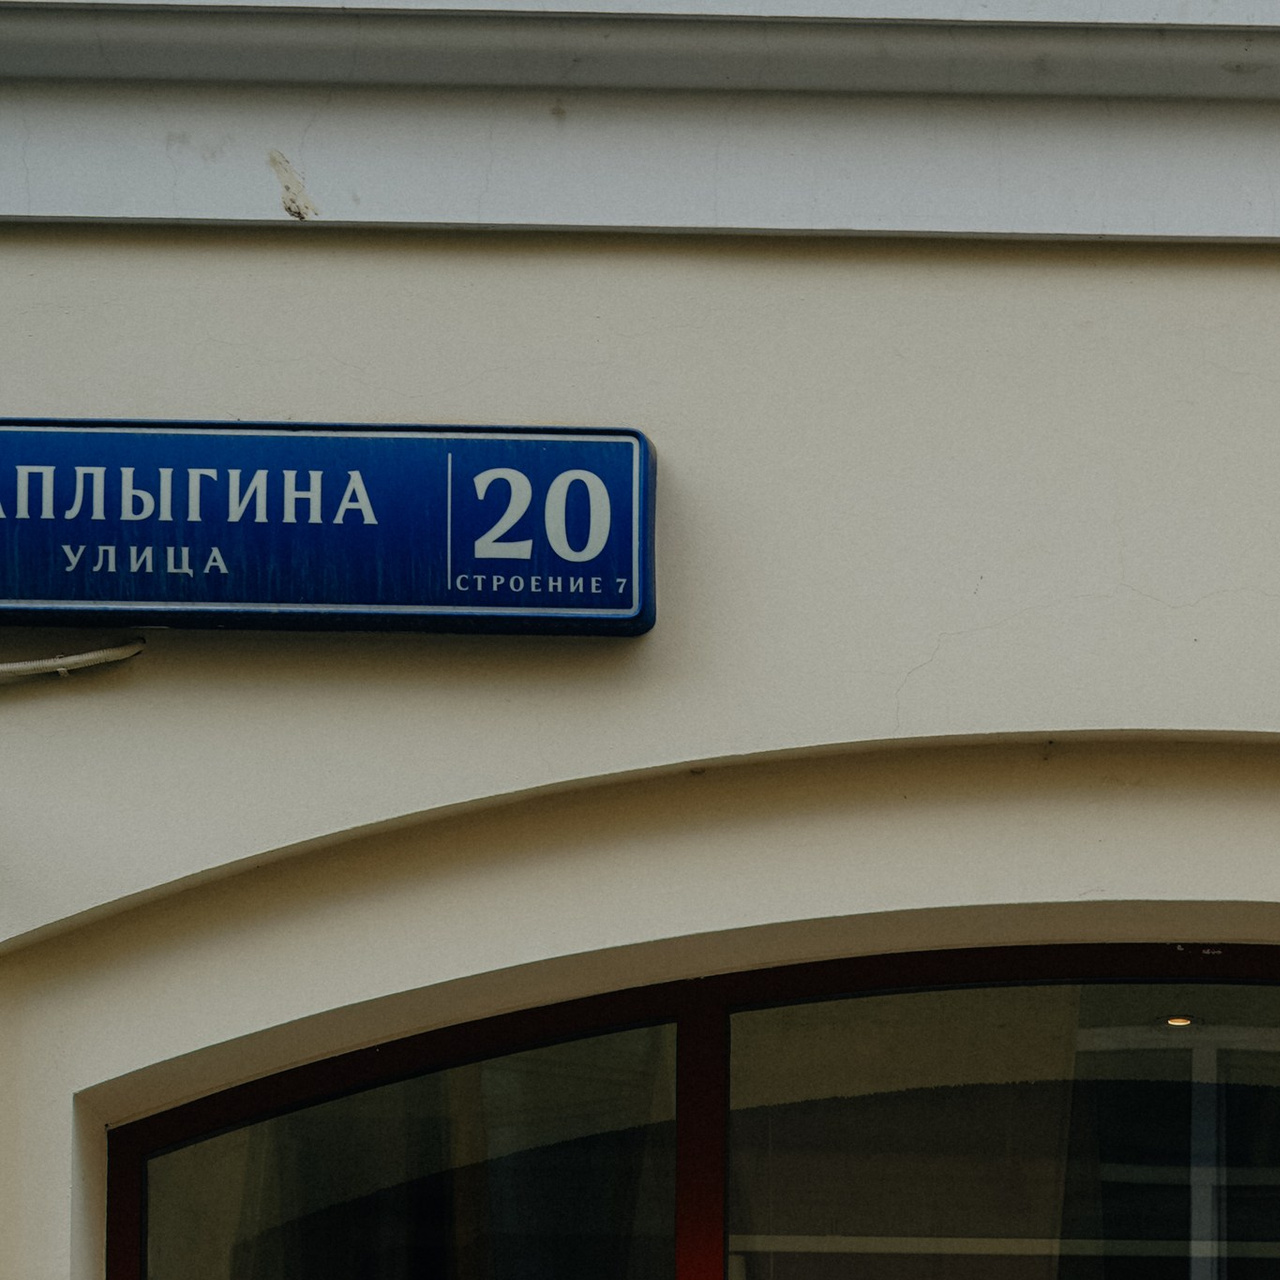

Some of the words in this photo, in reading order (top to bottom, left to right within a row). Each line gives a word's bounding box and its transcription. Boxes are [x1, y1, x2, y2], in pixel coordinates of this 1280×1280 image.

[0, 465, 378, 525] ПЛЫГИНА
[473, 467, 611, 562] 20
[61, 545, 228, 577] УЛИЦА
[455, 574, 603, 594] СТРОЕНИЕ
[615, 578, 628, 594] 7
